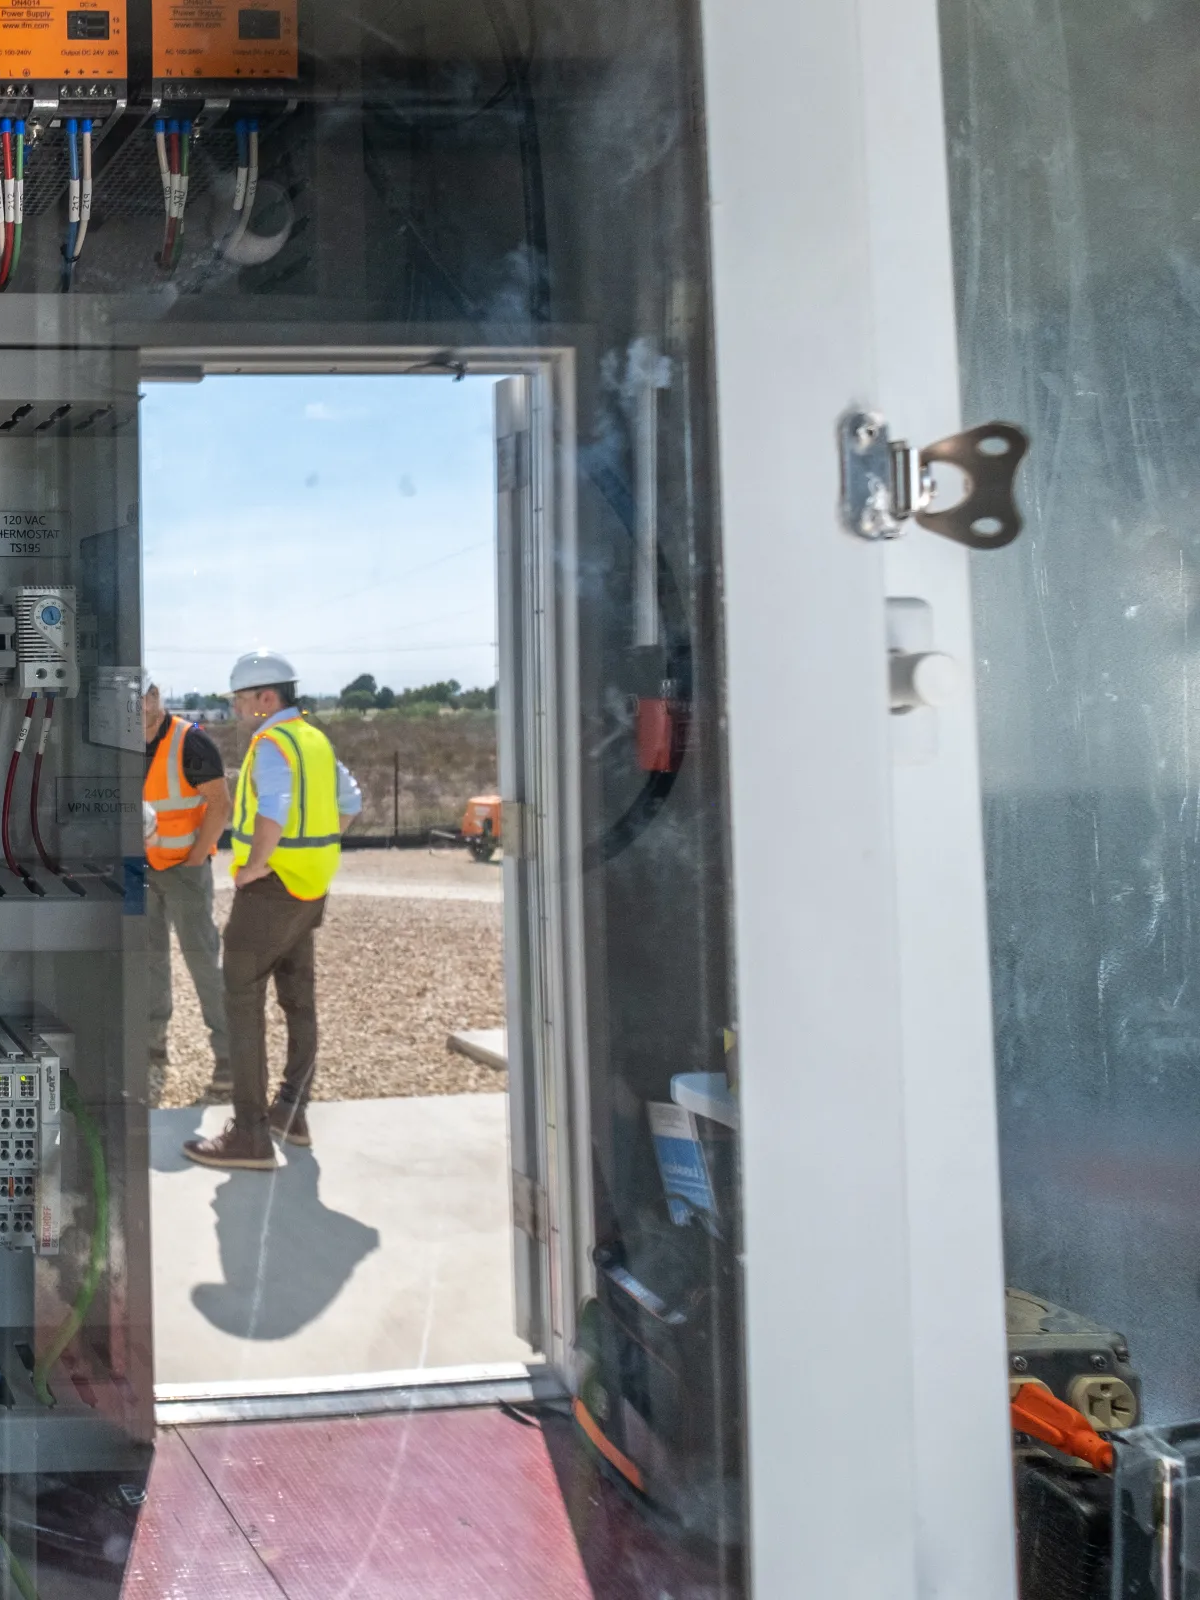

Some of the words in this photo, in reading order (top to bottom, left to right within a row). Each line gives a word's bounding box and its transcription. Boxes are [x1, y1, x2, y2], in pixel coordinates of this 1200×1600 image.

[26, 10, 51, 18] Supply
[82, 193, 90, 209] 219
[3, 515, 22, 525] 120
[24, 515, 46, 525] VAC
[10, 543, 41, 553] TS195
[18, 728, 28, 742] 195
[85, 789, 121, 799] 24VDC
[68, 803, 90, 813] VPN
[94, 802, 137, 813] ROUTER
[42, 1205, 52, 1248] BECKHOFF
